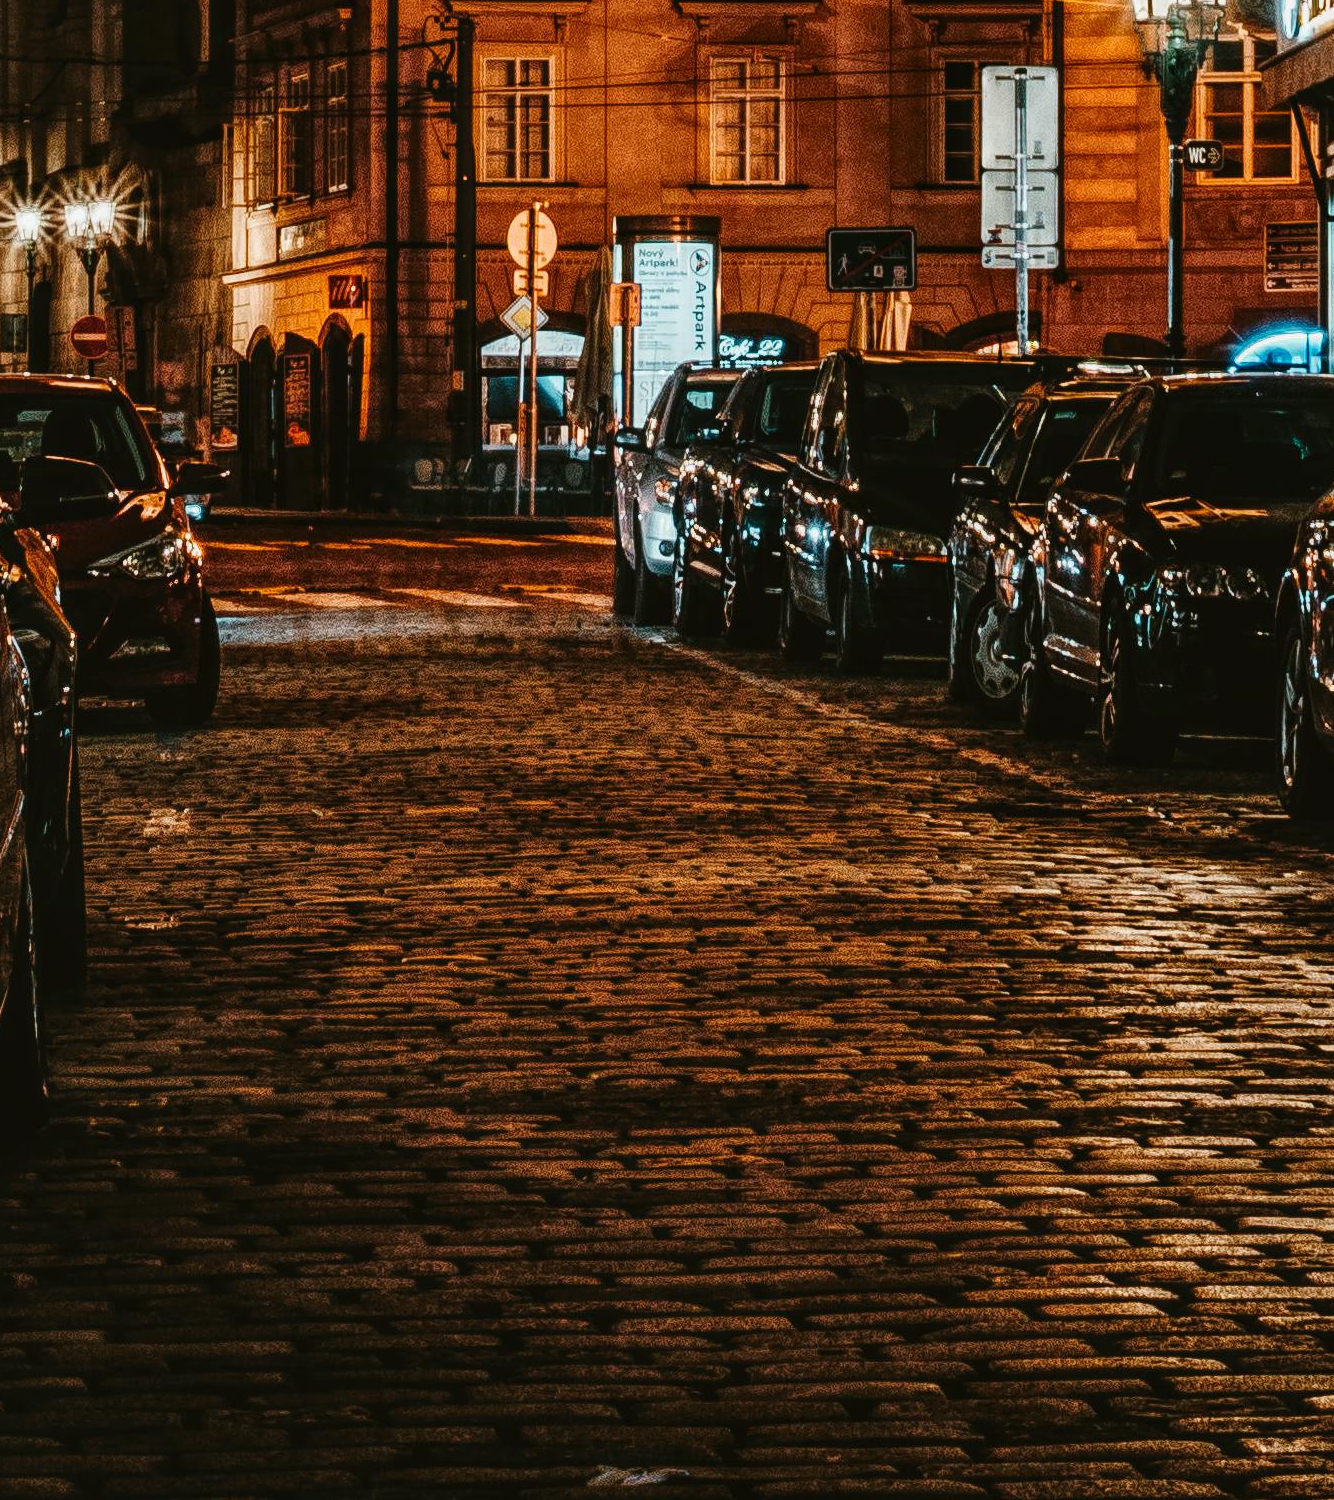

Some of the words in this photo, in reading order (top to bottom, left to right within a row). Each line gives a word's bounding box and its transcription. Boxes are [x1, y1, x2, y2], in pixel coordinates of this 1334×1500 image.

[1188, 147, 1207, 164] WC
[638, 248, 664, 259] Nový
[692, 280, 708, 351] Artpark
